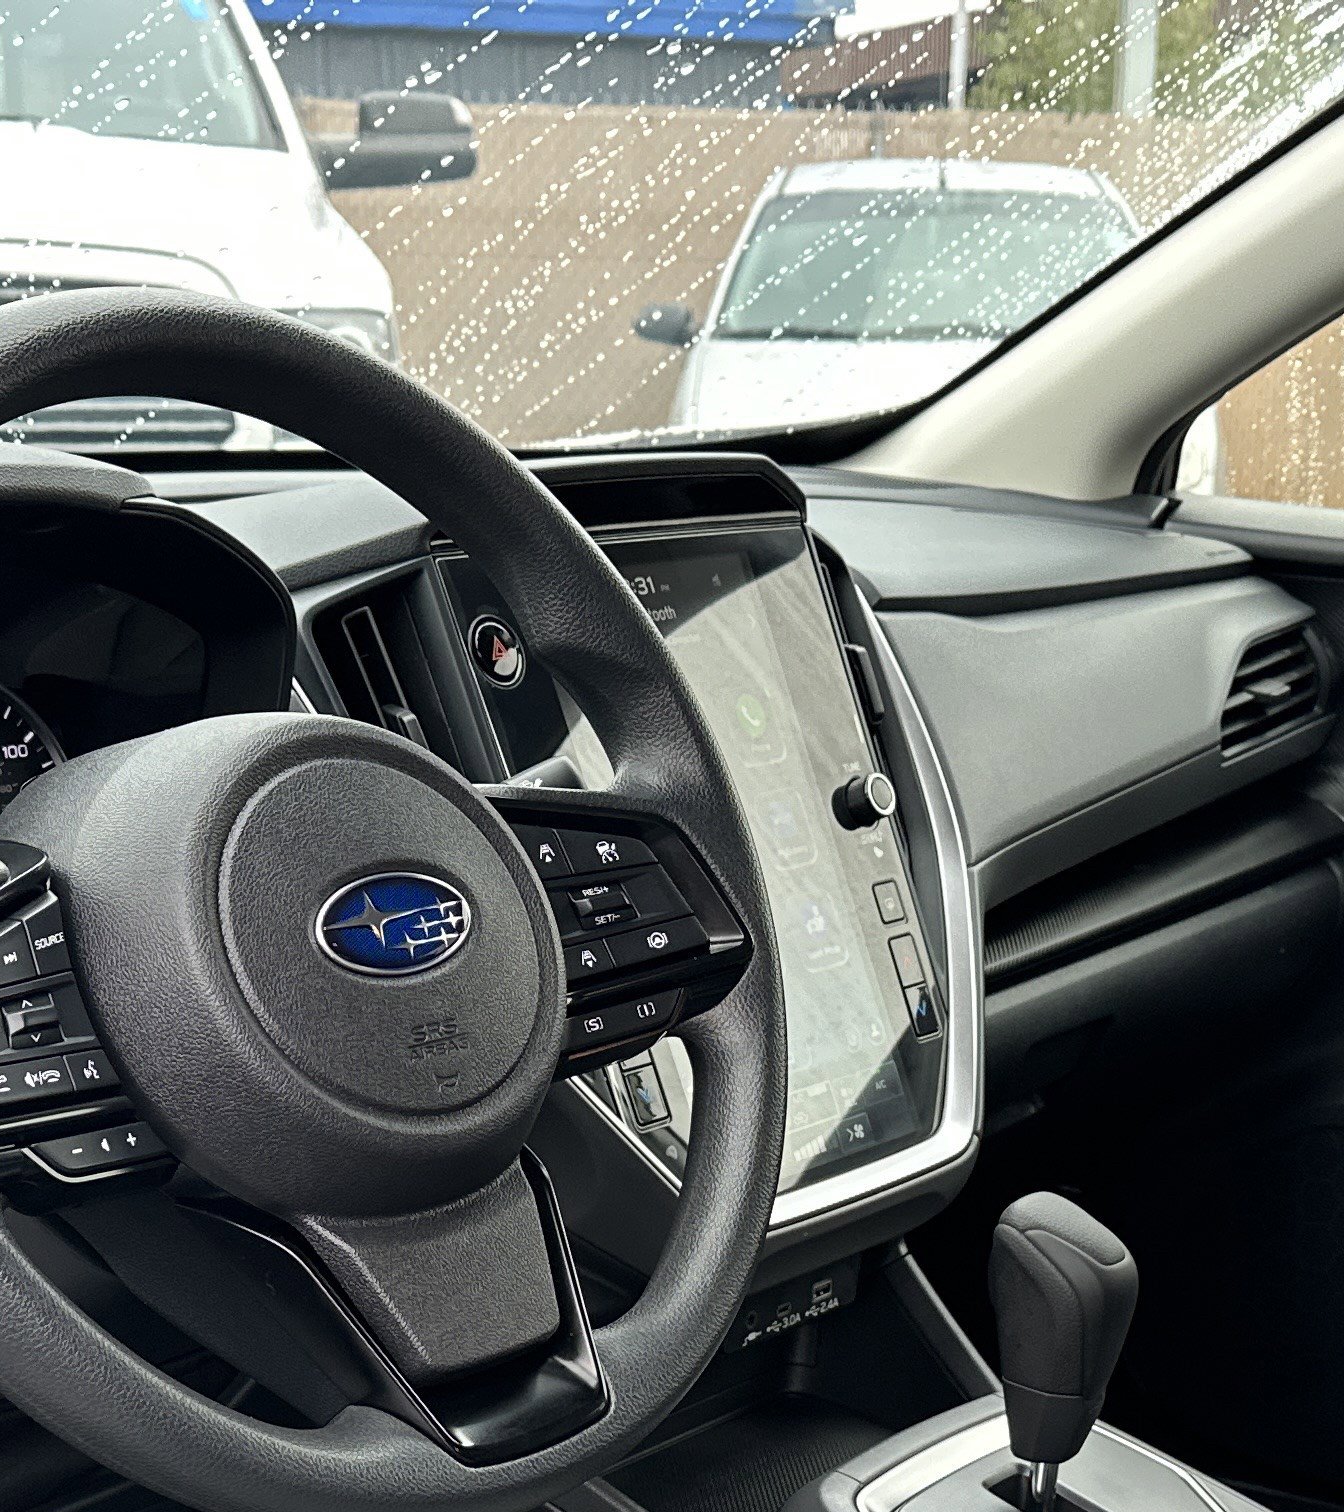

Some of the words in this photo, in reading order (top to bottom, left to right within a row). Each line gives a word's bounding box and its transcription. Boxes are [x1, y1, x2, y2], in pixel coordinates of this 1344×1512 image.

[1, 744, 29, 759] 100
[34, 931, 65, 950] SOURCE
[411, 1018, 459, 1041] SRS
[410, 1040, 470, 1061] AIRBAG
